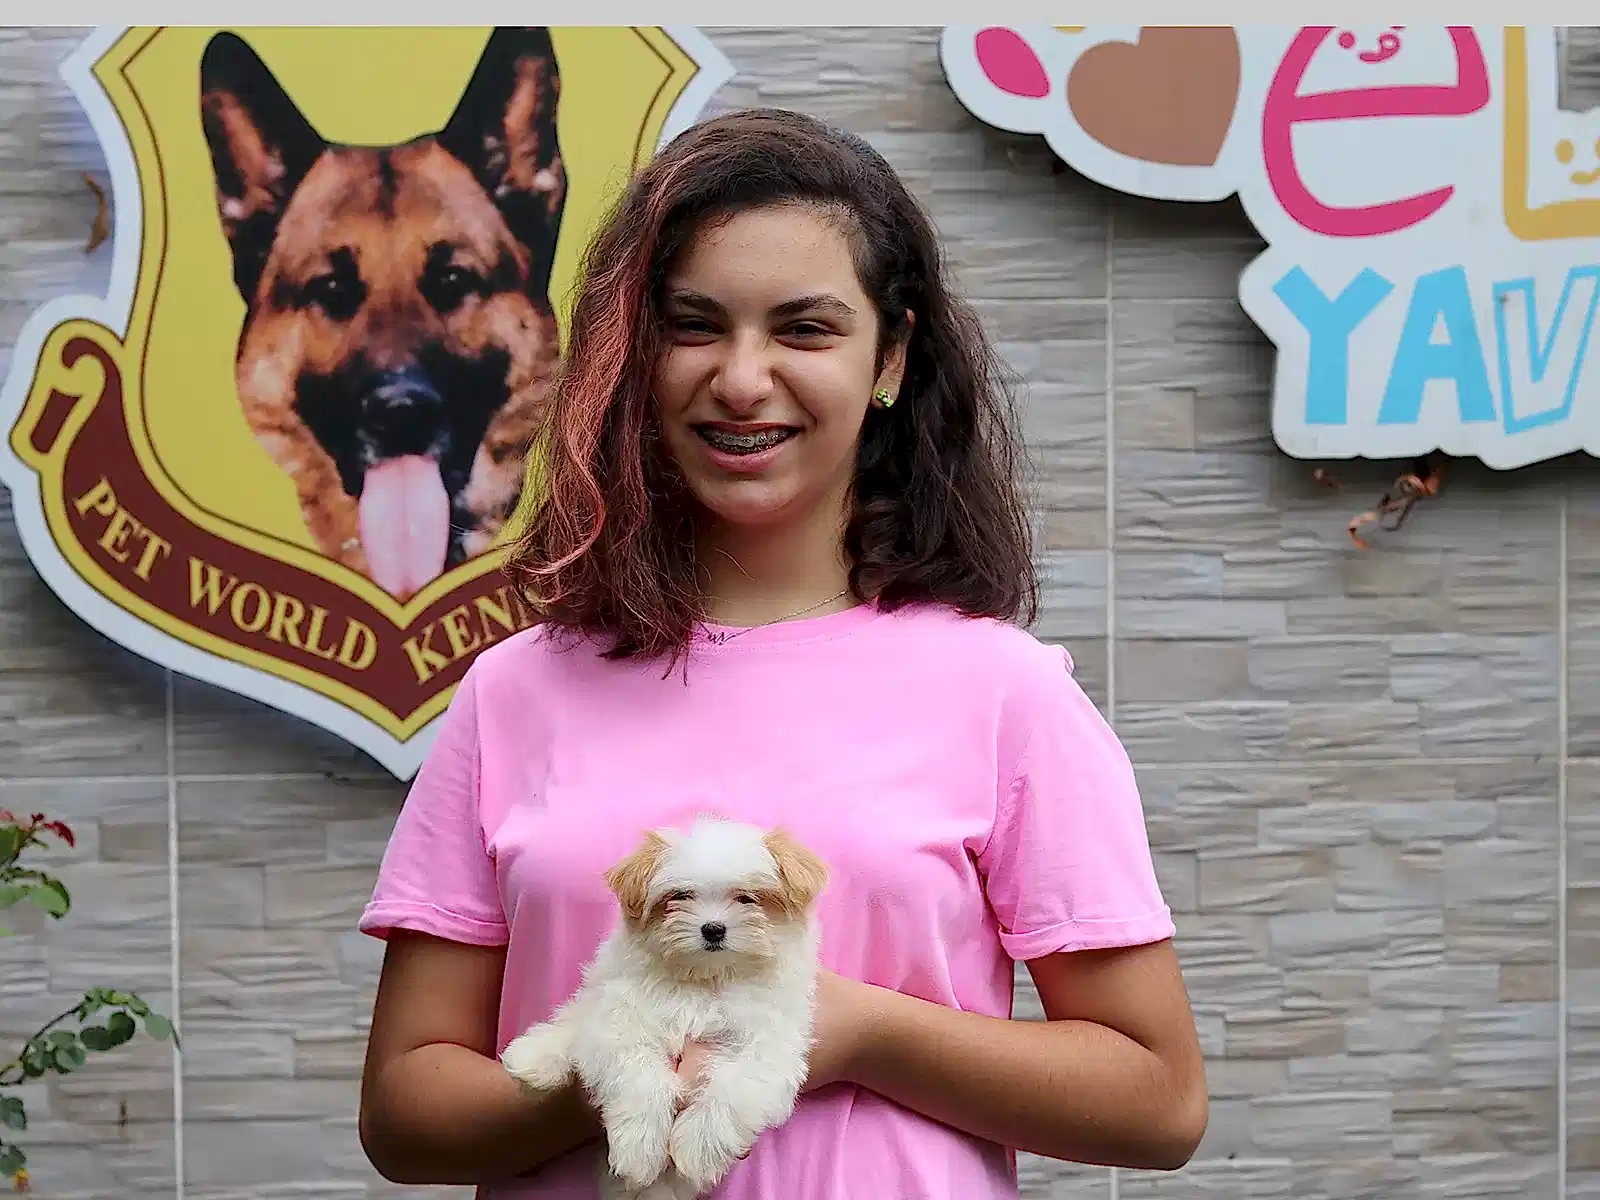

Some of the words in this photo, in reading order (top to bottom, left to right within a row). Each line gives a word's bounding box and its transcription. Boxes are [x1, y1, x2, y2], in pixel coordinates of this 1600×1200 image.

[1273, 265, 1600, 435] YAV
[72, 476, 171, 583] PET
[187, 556, 378, 670] WORLD
